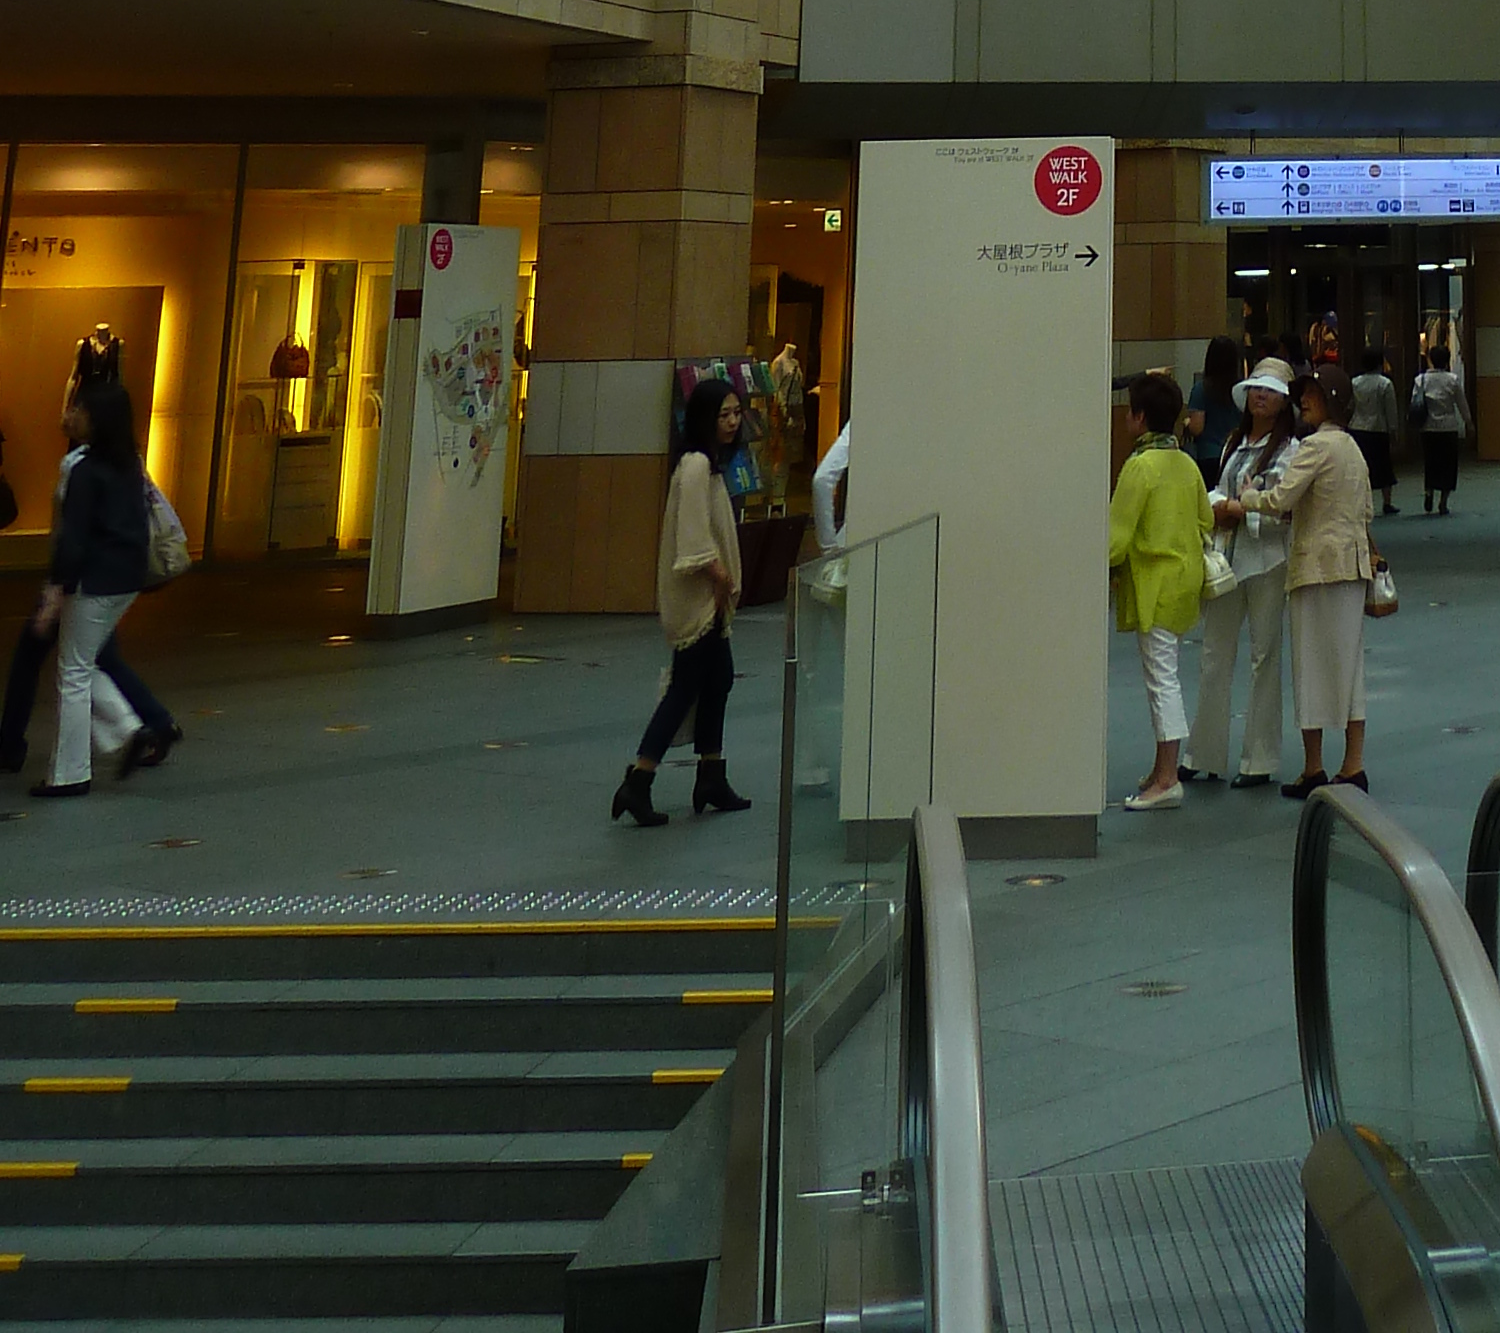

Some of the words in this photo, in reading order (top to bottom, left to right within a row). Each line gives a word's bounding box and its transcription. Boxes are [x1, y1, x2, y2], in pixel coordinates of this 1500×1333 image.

[1049, 156, 1088, 170] WEST
[1049, 171, 1088, 184] WALK
[1057, 188, 1080, 206] 2F
[976, 242, 1069, 261] 大屋根プラザ
[997, 263, 1039, 276] O-yane
[1042, 261, 1069, 273] Plaza
